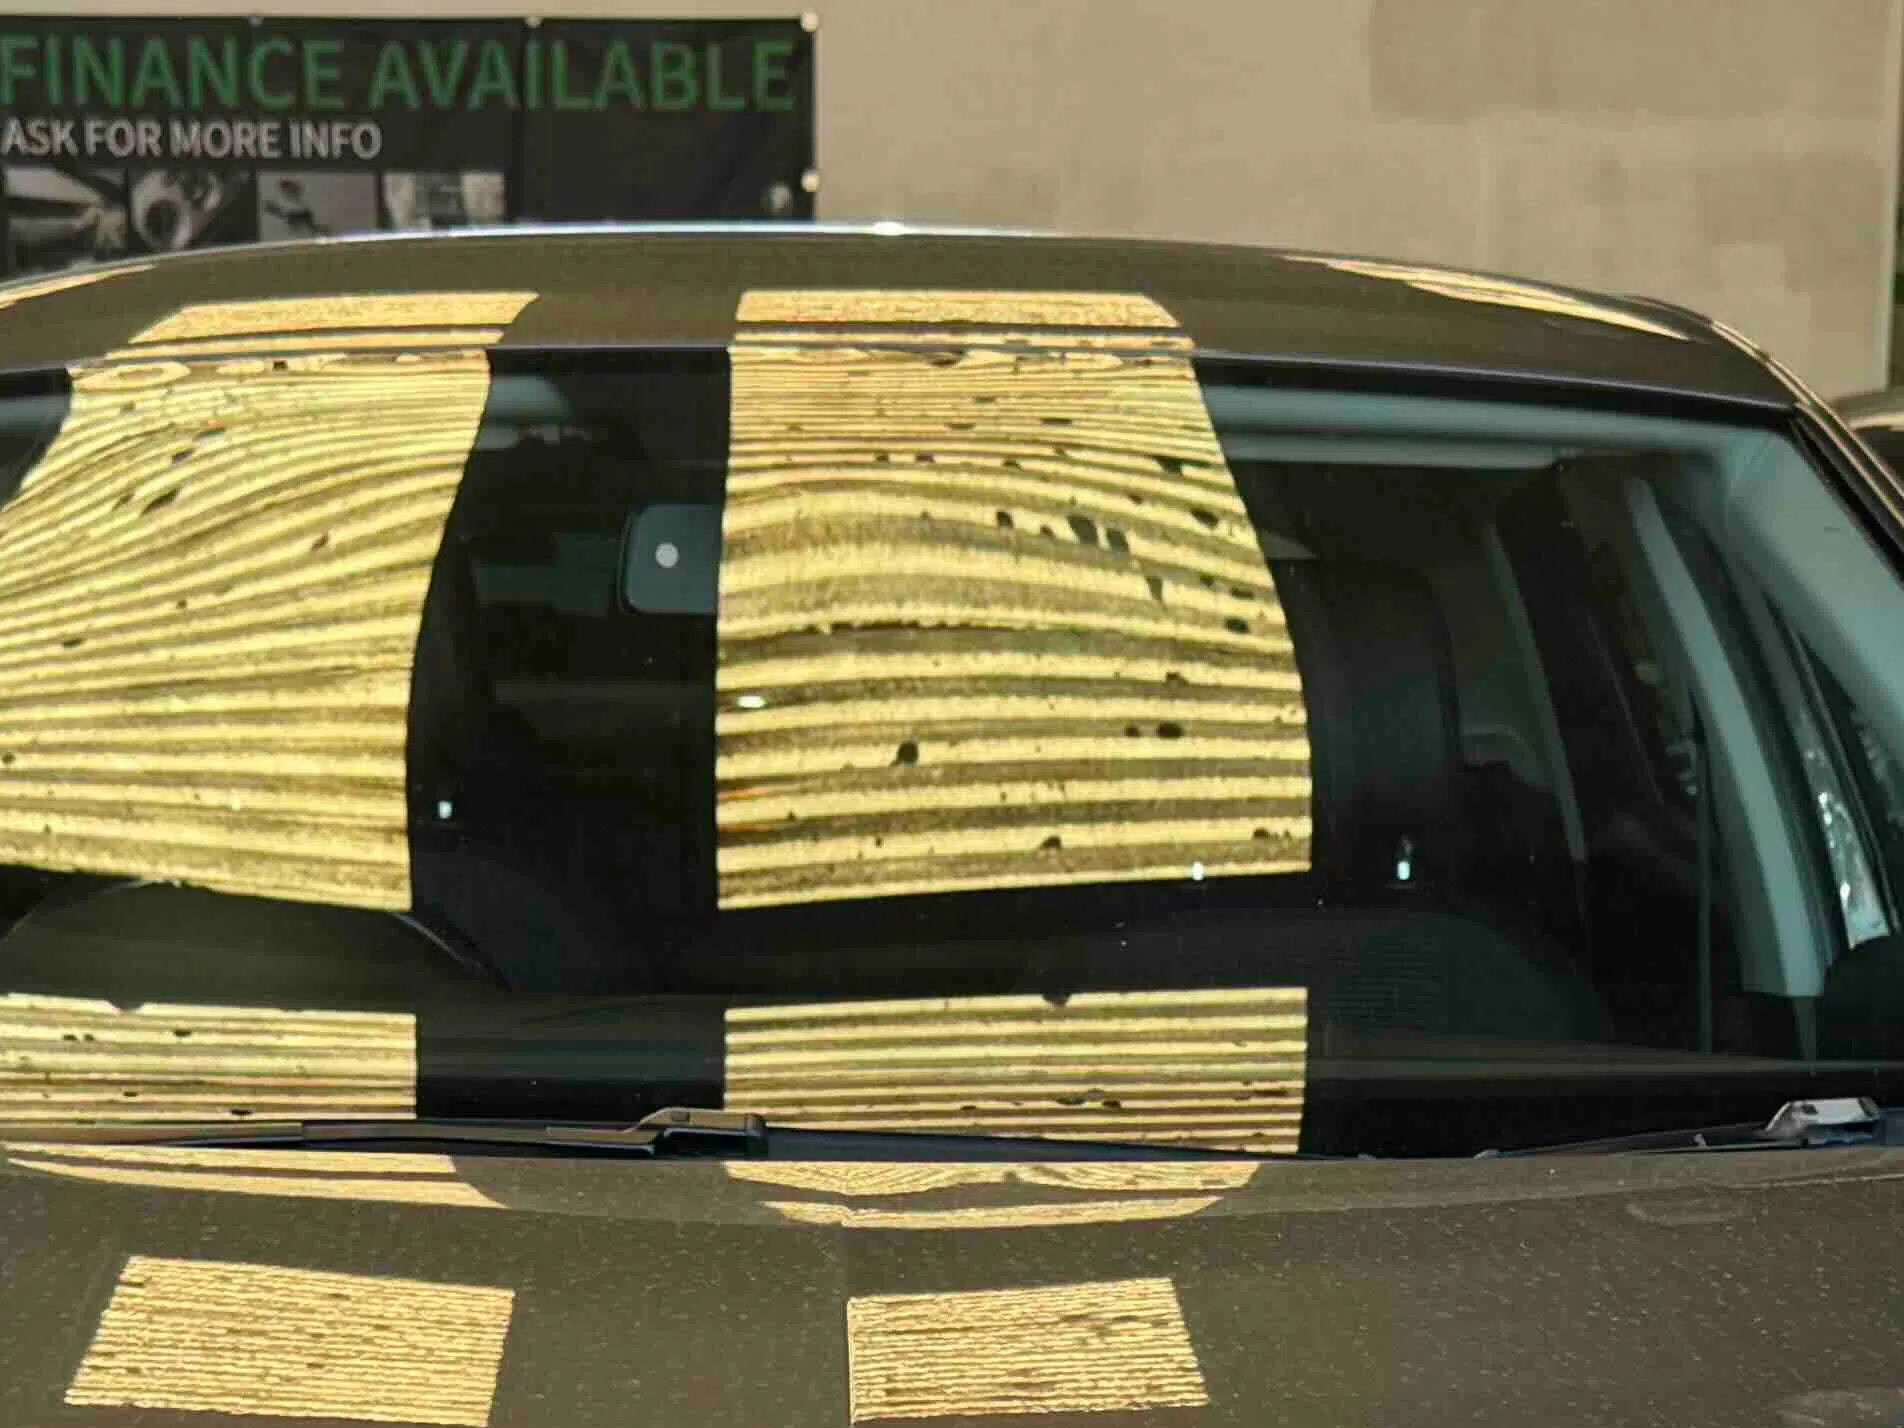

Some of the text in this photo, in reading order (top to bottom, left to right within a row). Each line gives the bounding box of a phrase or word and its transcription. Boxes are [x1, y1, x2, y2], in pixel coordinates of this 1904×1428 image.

[367, 37, 796, 112] AVAILABLE
[0, 119, 383, 160] ASK FOR MORE INFO
